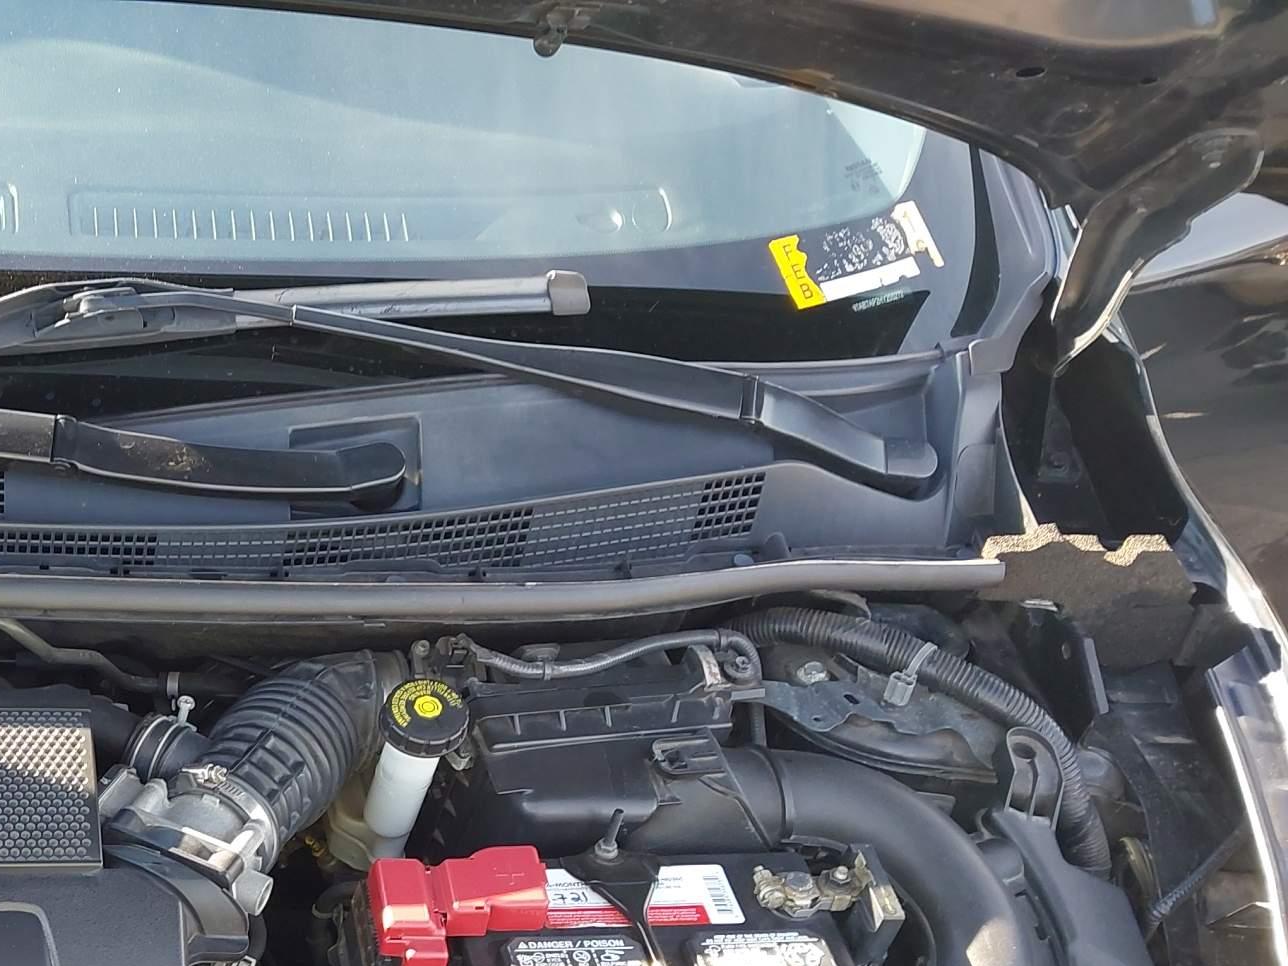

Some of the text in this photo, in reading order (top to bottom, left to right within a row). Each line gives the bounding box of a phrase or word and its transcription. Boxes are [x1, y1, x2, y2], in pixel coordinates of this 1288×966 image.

[782, 243, 813, 300] FEB
[527, 941, 573, 949] DANGER
[583, 939, 625, 947] POISON
